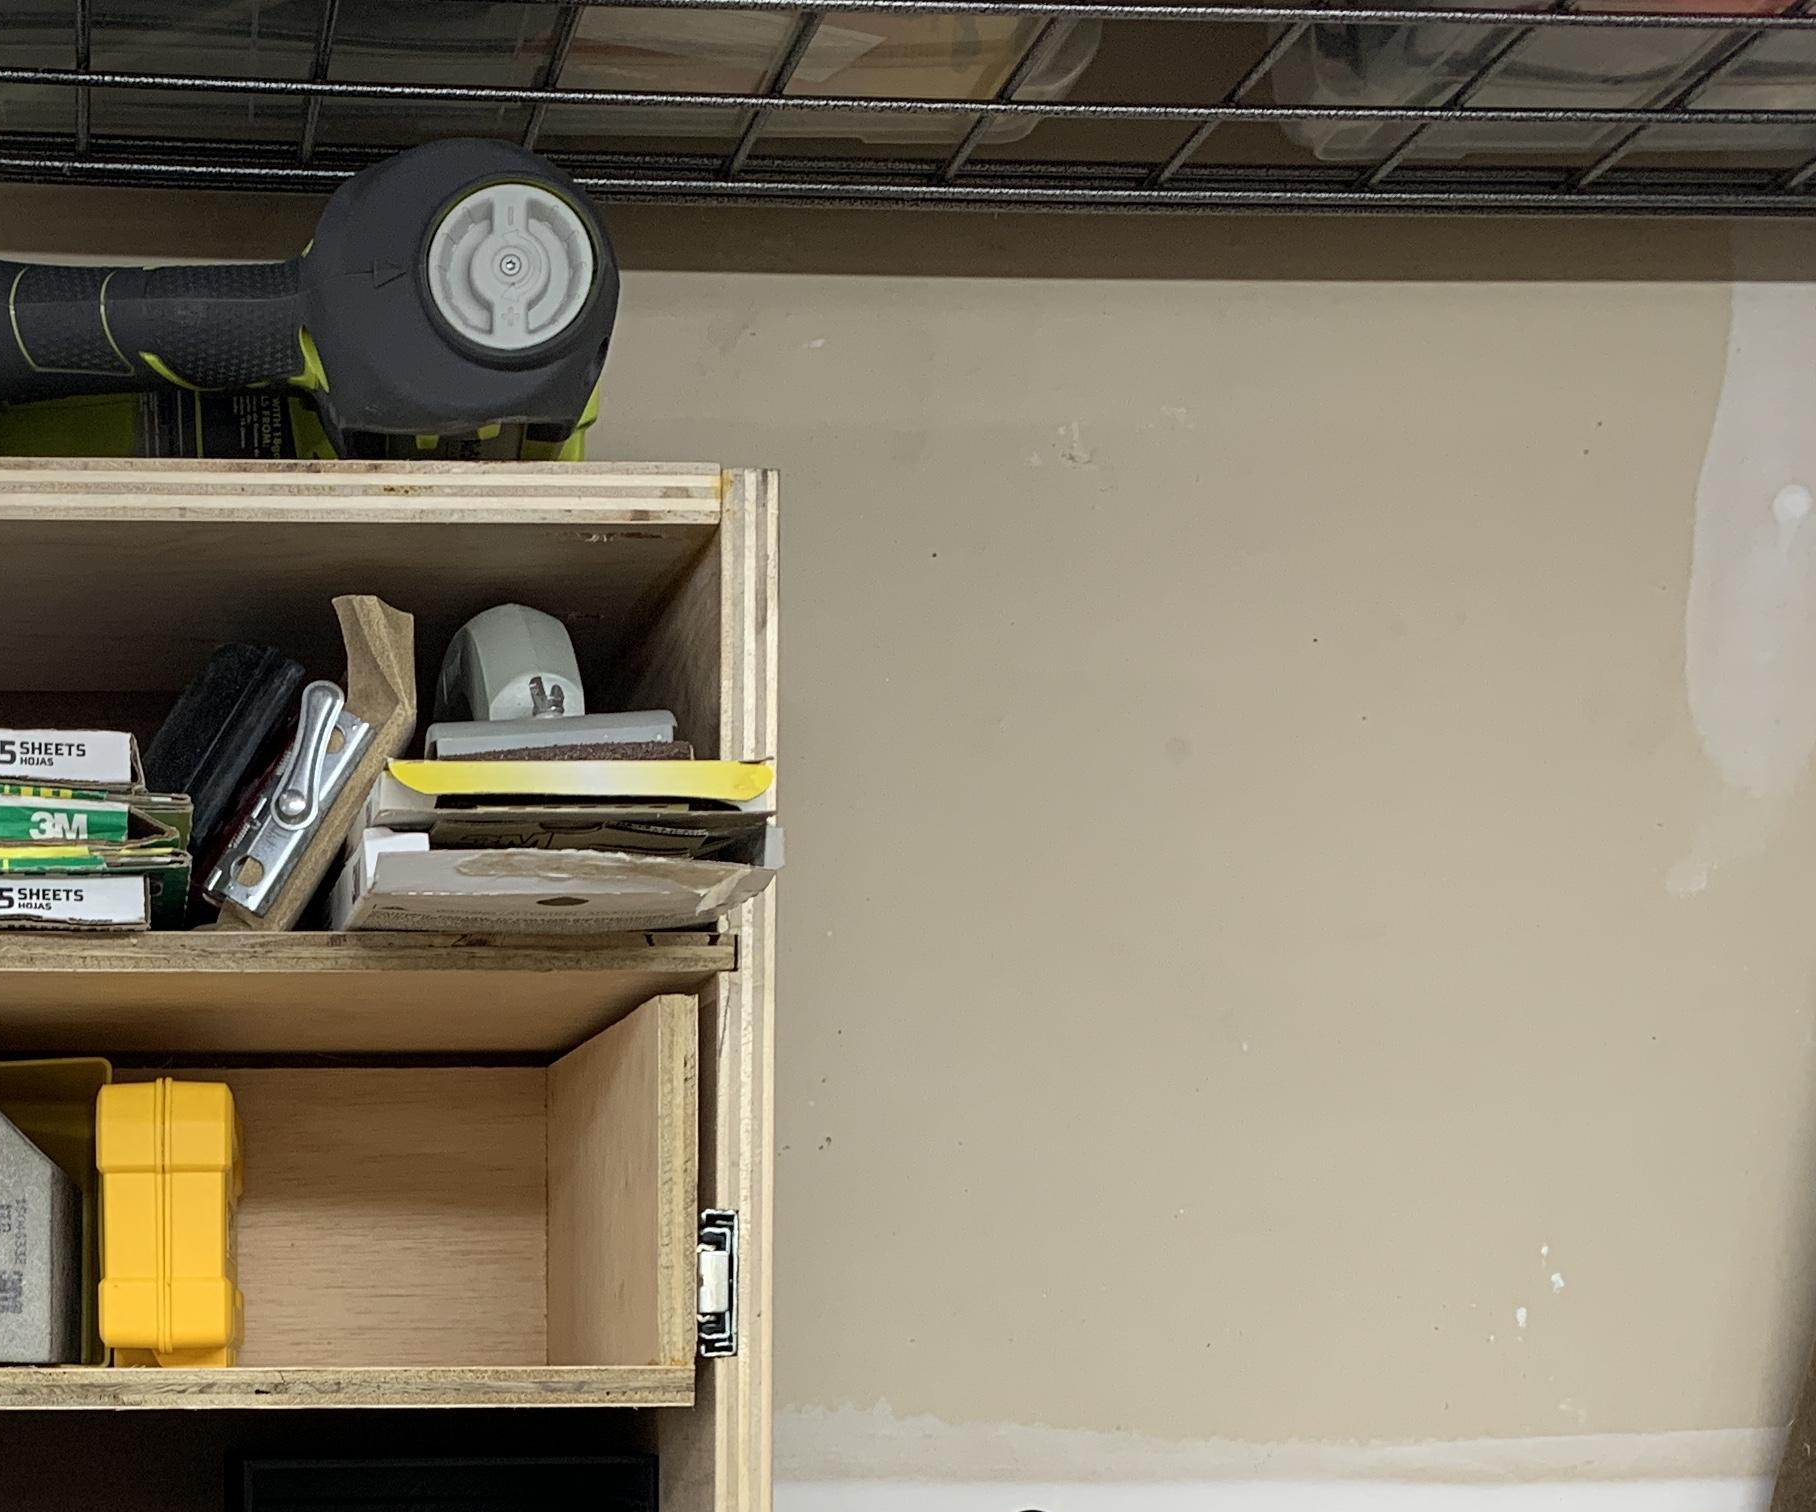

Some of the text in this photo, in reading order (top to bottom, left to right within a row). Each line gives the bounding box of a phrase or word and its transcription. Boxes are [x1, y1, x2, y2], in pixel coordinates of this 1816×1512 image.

[19, 741, 87, 758] SHEETS
[19, 756, 54, 767] HOJAS
[28, 811, 88, 841] 3M
[17, 887, 84, 903] SHEETS
[17, 901, 52, 911] HOJAS
